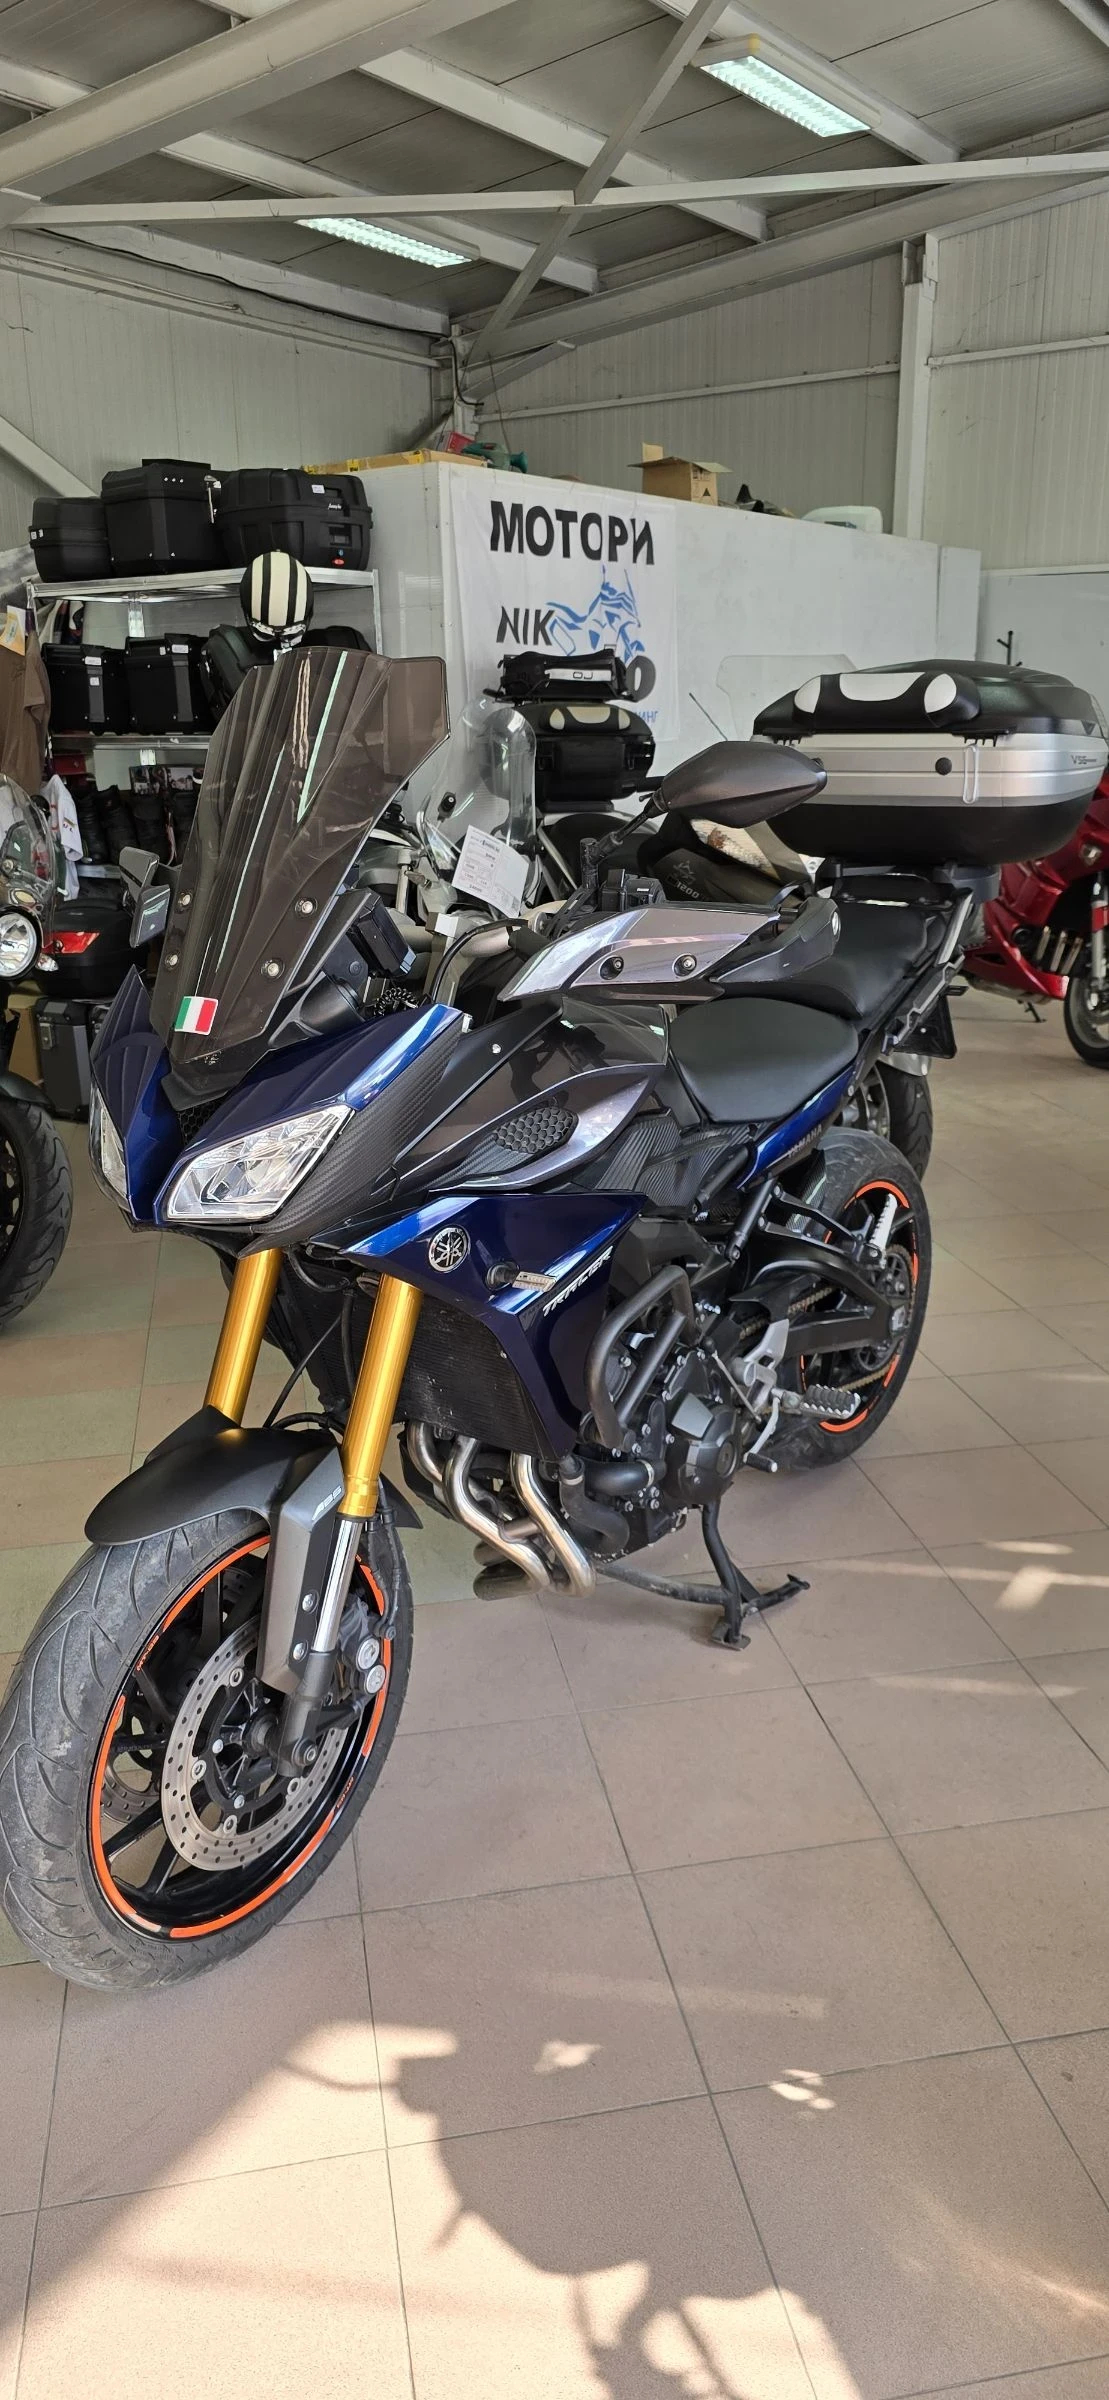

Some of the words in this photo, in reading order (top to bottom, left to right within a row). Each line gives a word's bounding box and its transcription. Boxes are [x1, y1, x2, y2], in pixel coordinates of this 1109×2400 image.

[490, 500, 655, 565] МОТОРИ
[496, 605, 556, 646] NIK
[572, 671, 594, 680] OJ
[676, 879, 700, 899] 1200
[788, 1123, 823, 1158] YAMAHA
[542, 1245, 613, 1318] TRACER
[311, 1485, 342, 1521] ABS
